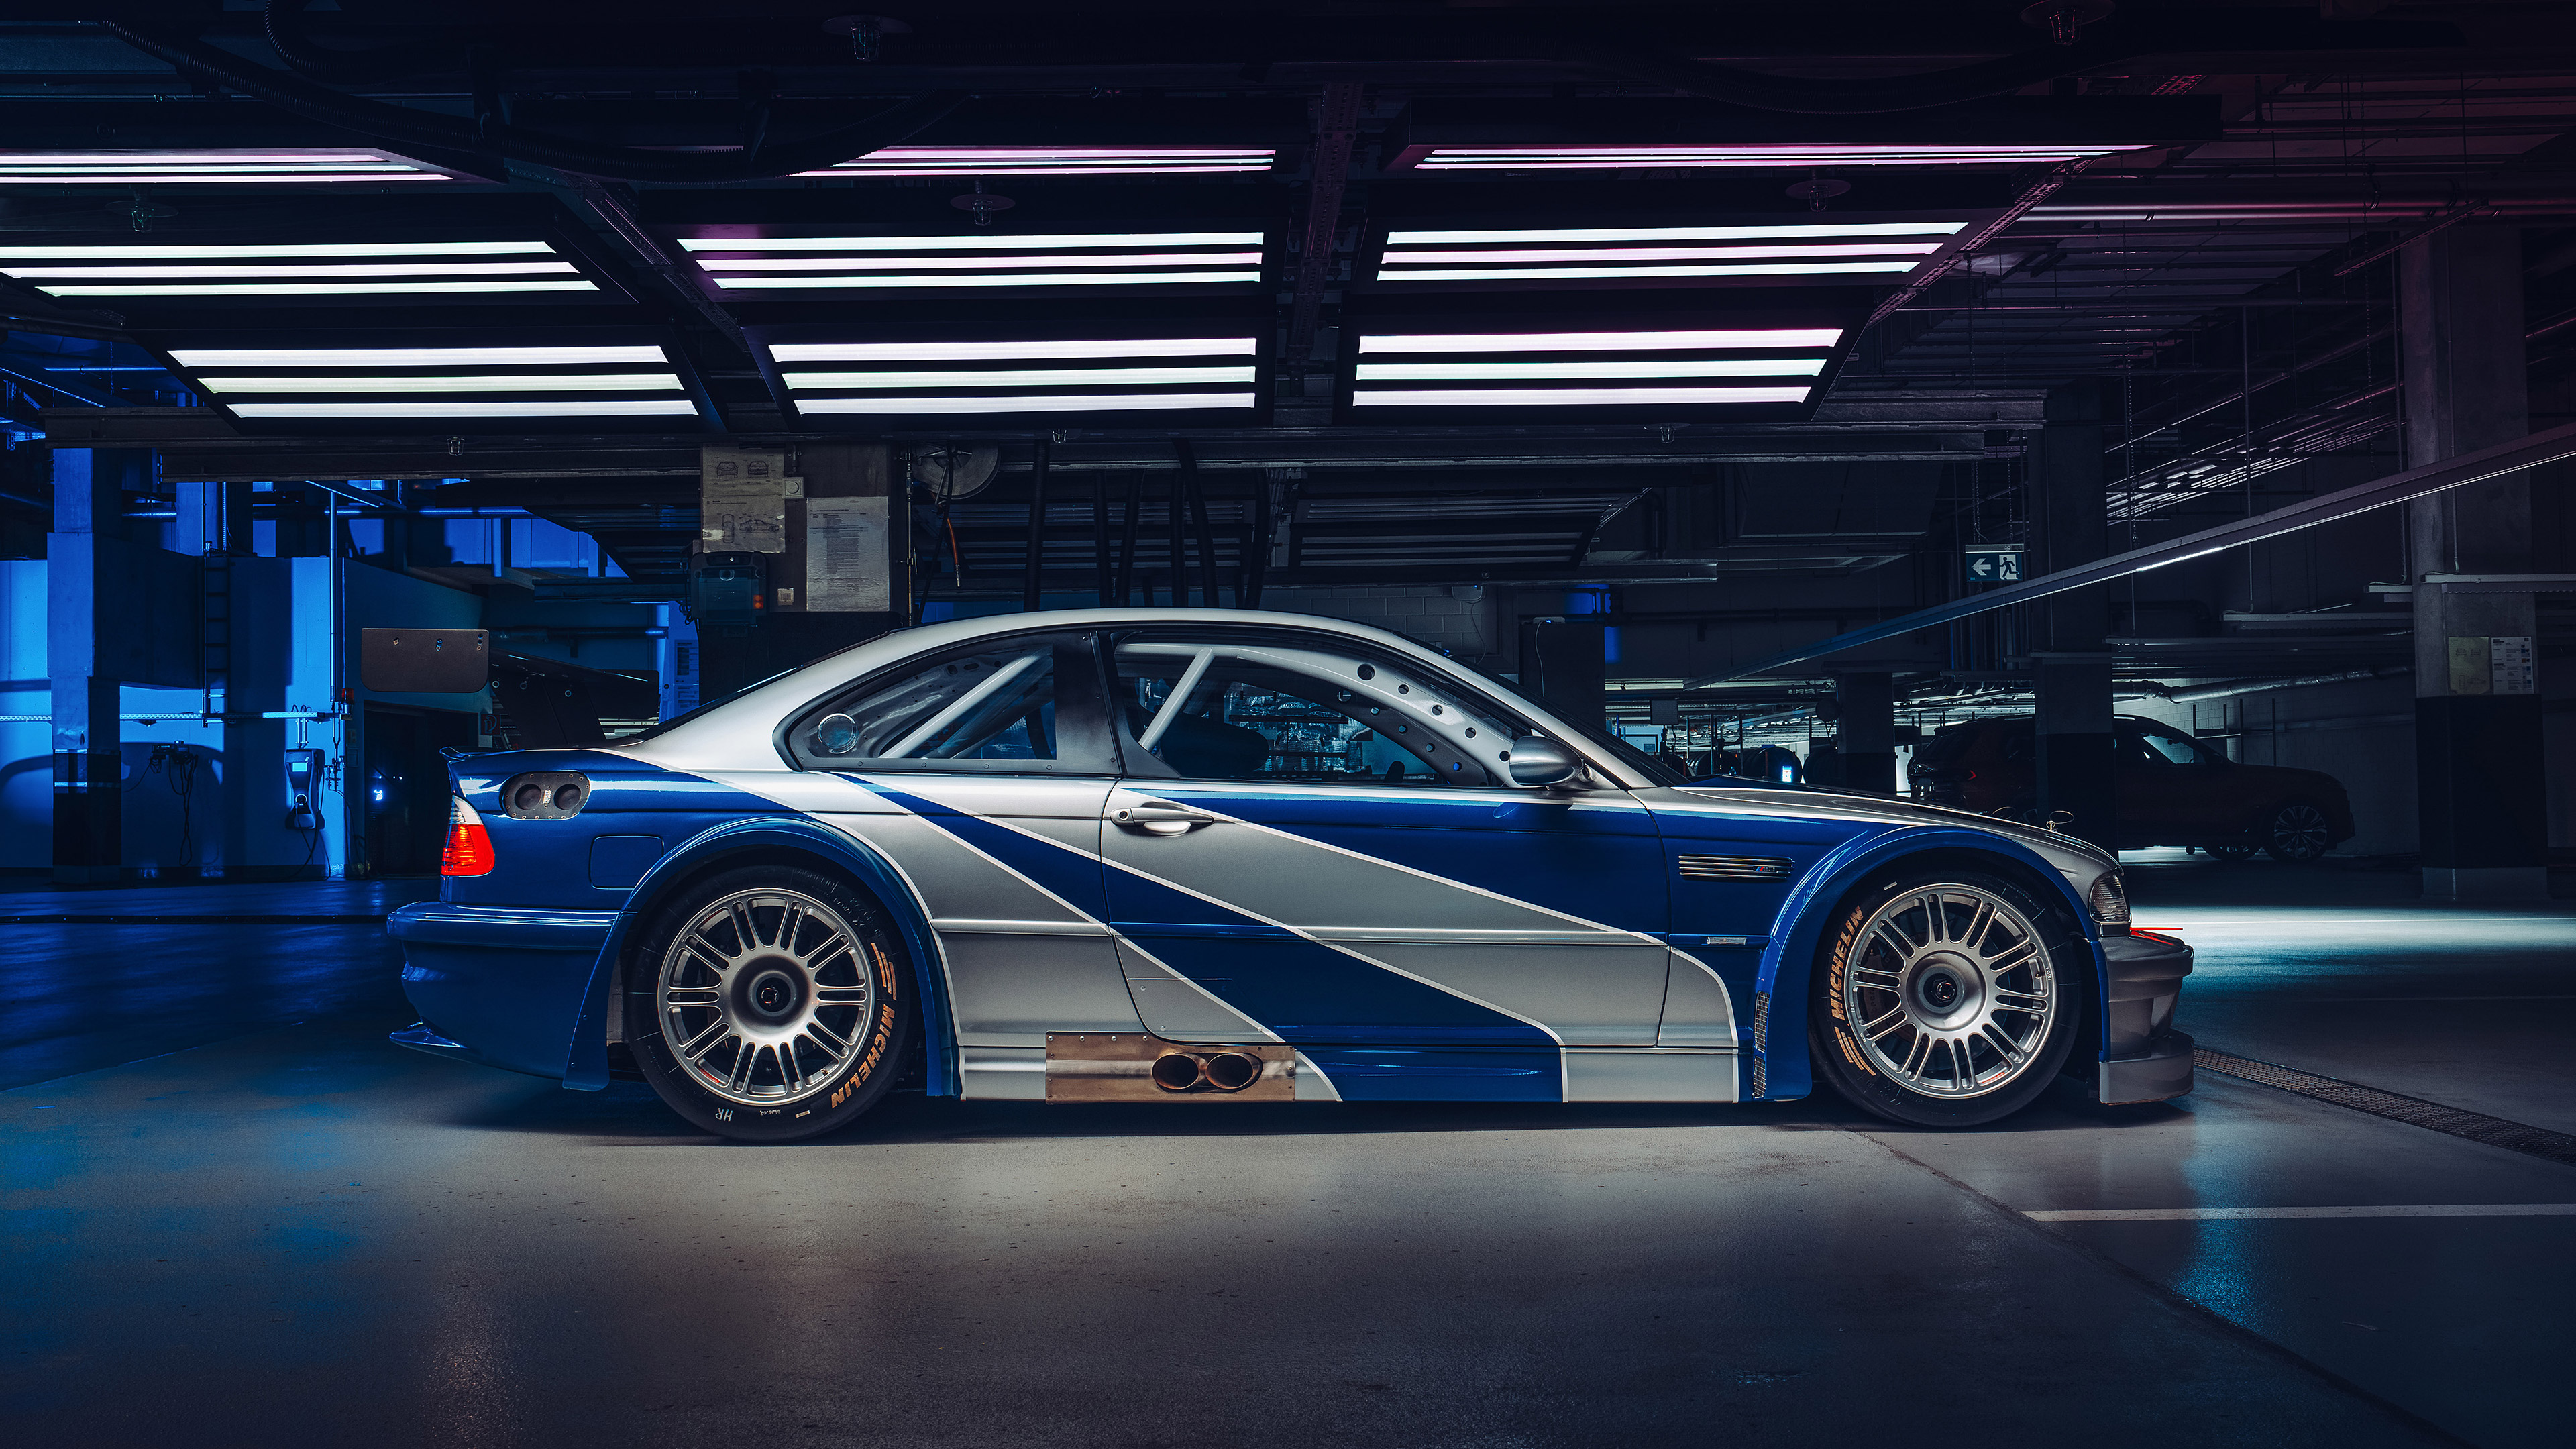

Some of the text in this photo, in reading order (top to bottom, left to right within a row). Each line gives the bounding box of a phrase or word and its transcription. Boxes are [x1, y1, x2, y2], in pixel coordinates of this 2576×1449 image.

[1829, 905, 1864, 1021] MICHELIN
[831, 1004, 895, 1109] MICHELIN
[715, 1107, 735, 1122] HR
